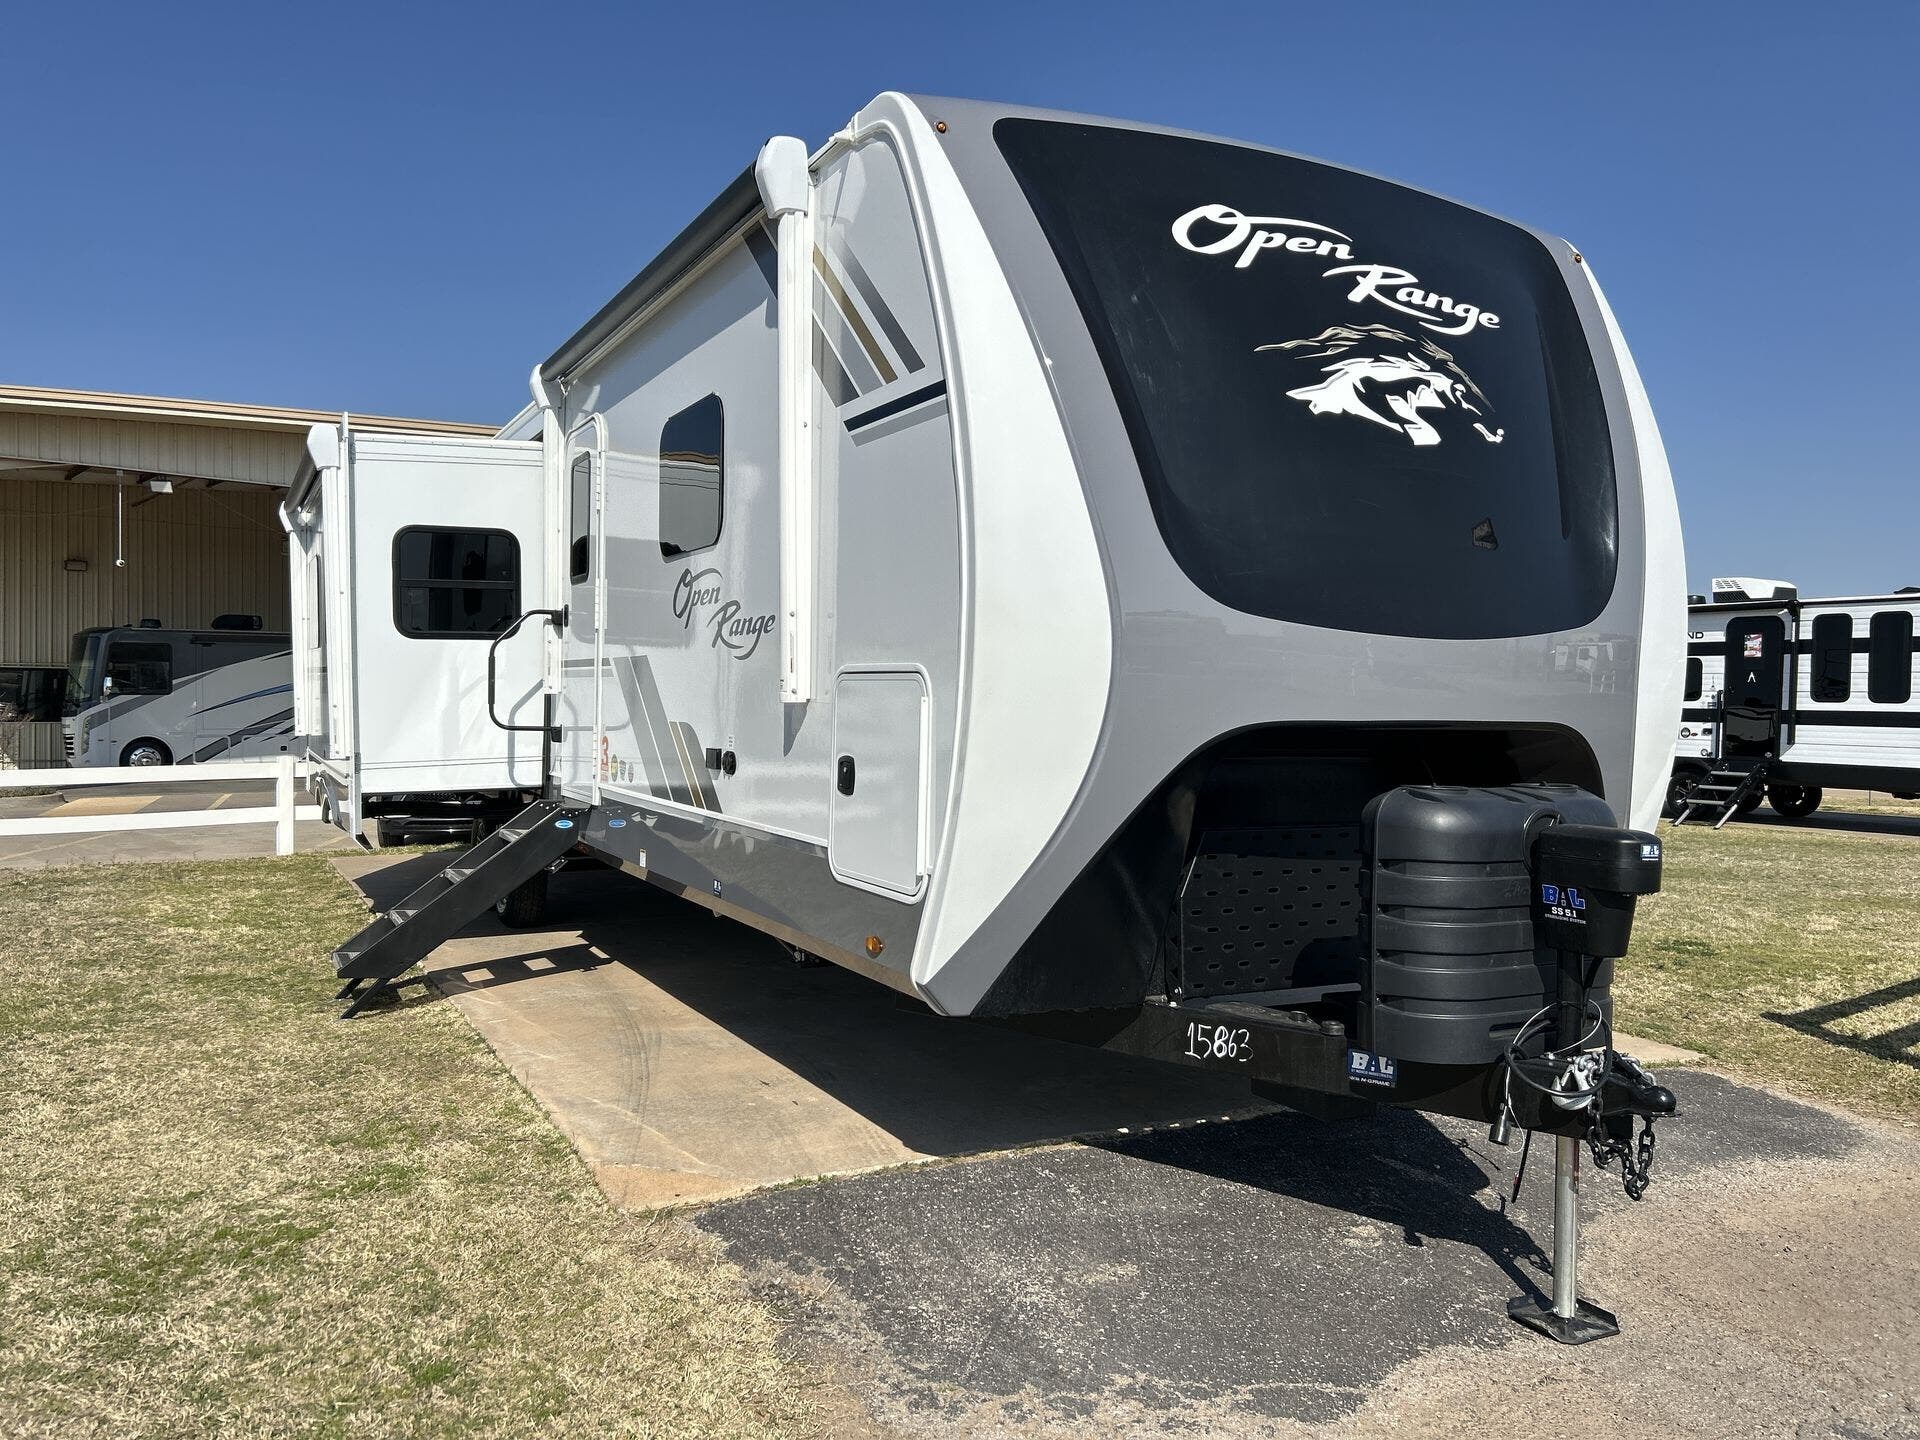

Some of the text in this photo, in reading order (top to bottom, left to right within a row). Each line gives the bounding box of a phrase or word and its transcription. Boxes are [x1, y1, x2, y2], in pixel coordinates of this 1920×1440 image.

[1171, 203, 1354, 269] Open
[1321, 263, 1501, 336] Range
[673, 567, 723, 629] Open
[706, 600, 776, 660] Range
[1551, 906, 1564, 916] SS
[1184, 1021, 1254, 1062] 15863
[1351, 1051, 1394, 1075] BAL
